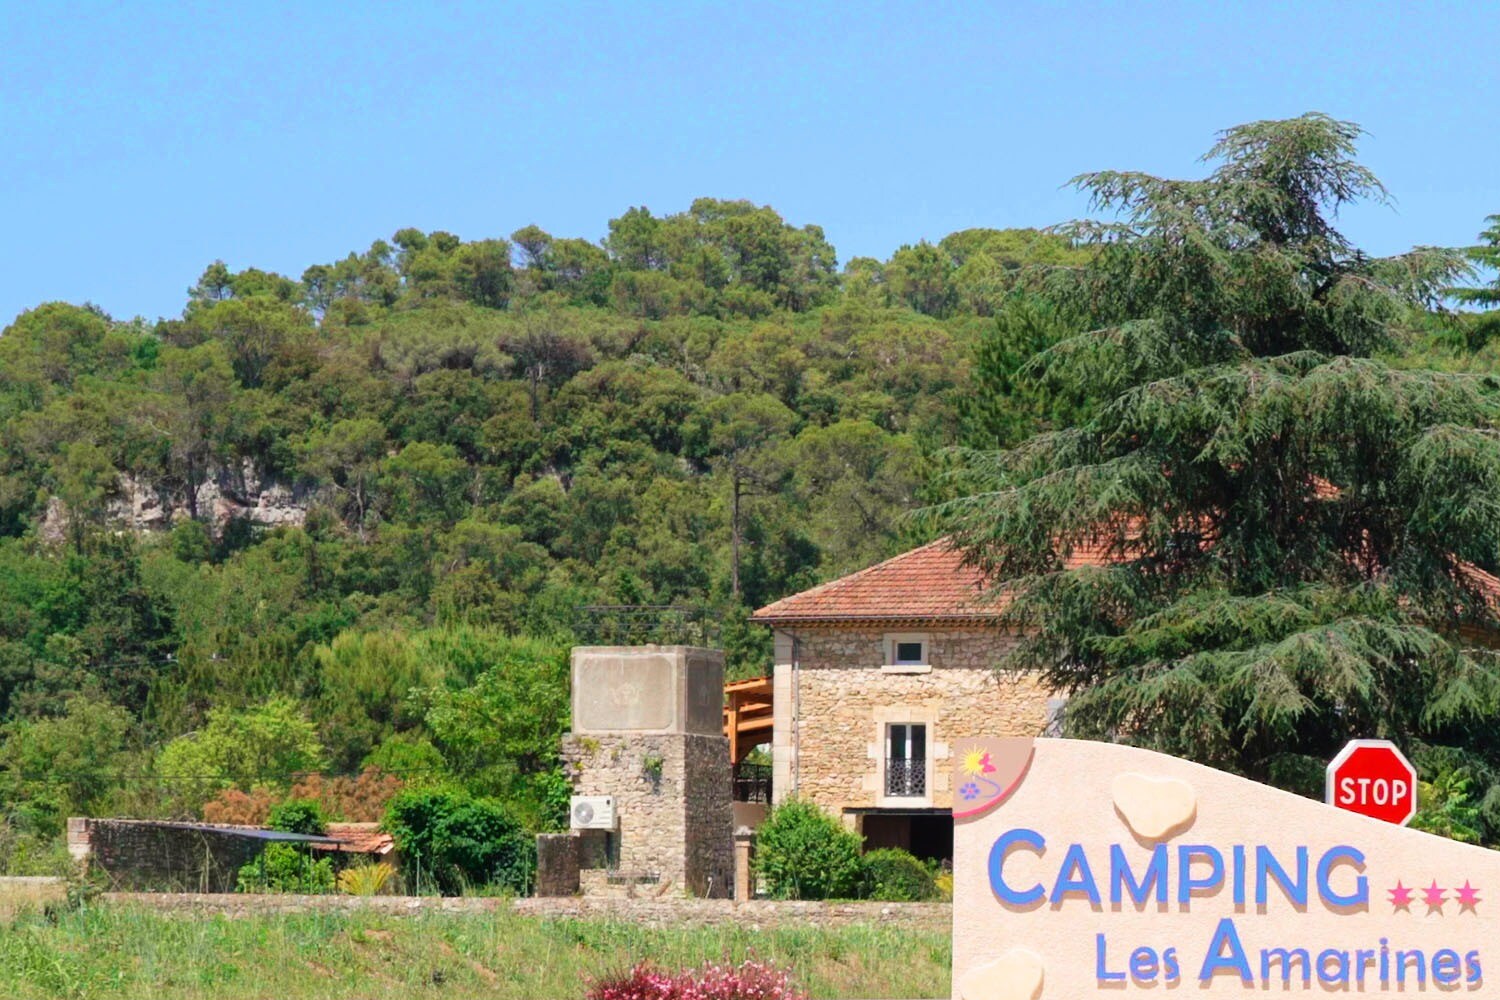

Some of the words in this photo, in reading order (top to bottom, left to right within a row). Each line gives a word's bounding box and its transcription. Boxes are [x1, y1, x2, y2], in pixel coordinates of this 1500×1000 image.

[1340, 777, 1407, 806] STOP
[987, 828, 1370, 907] CAMPING
[1096, 933, 1181, 981] Les
[1199, 917, 1484, 983] Amarines
